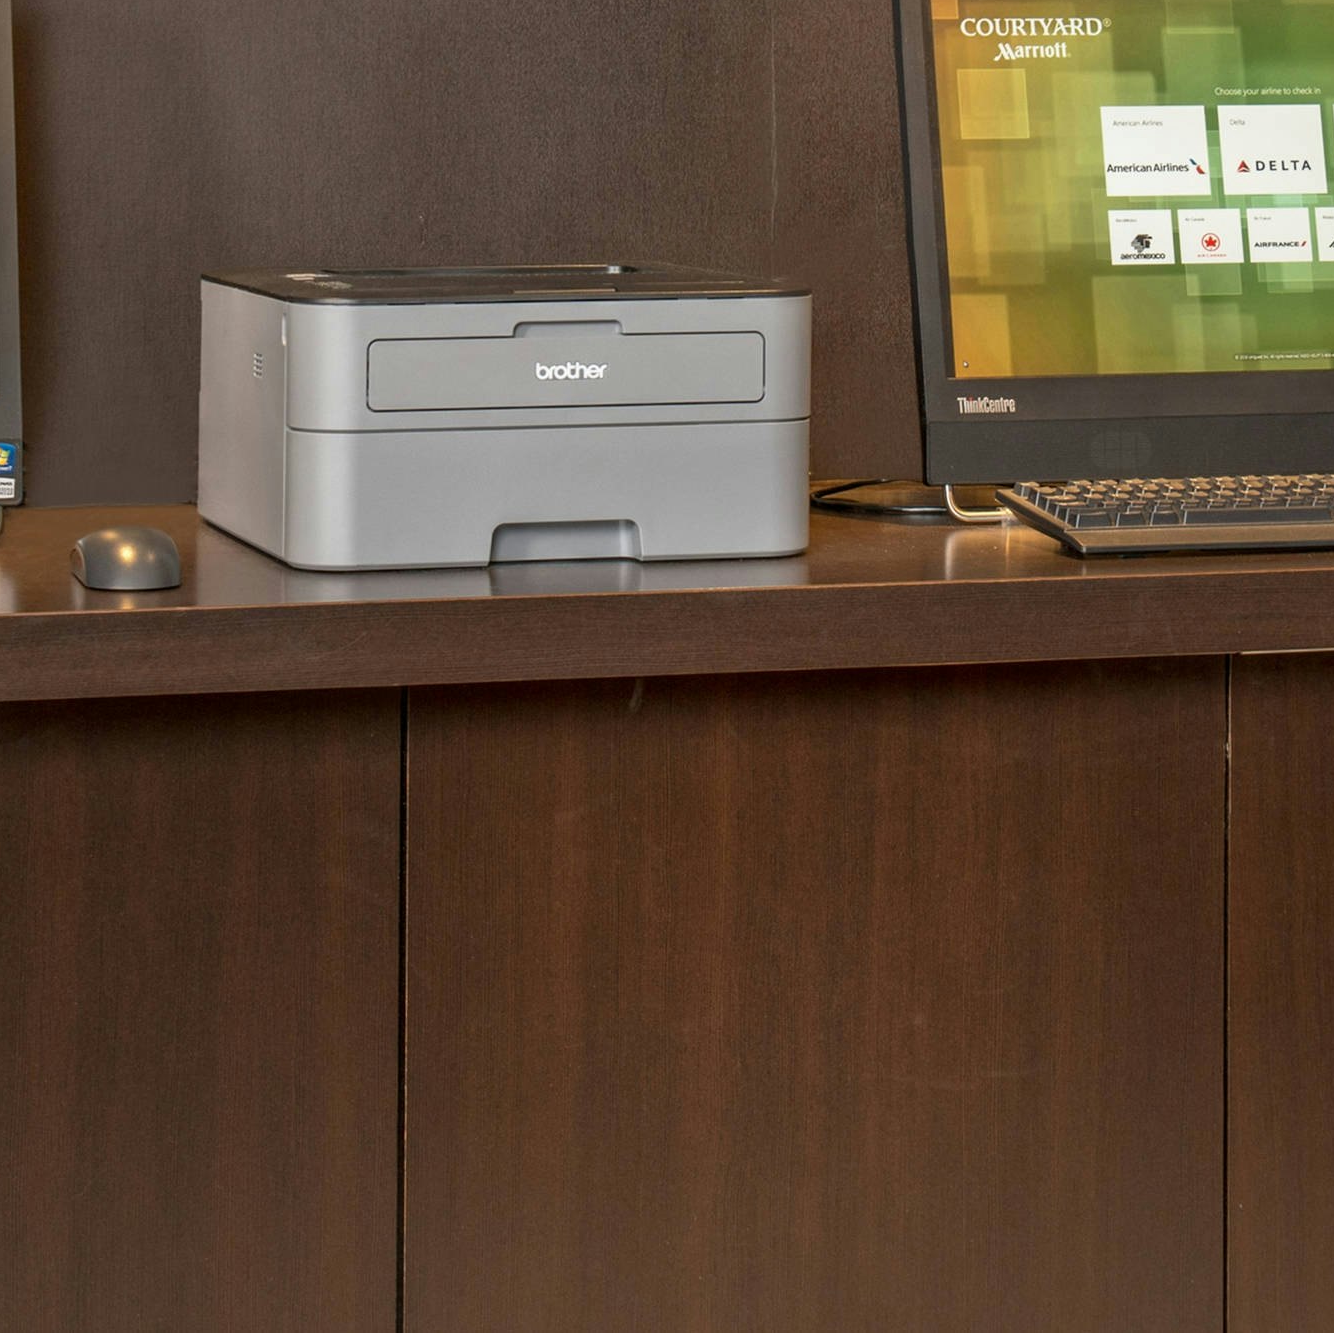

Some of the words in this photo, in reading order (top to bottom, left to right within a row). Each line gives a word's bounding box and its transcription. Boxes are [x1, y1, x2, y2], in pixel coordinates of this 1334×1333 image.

[960, 17, 1103, 37] COURTYARD
[993, 42, 1068, 62] Marriott
[1214, 86, 1242, 96] Choose
[1242, 88, 1260, 97] your
[1260, 87, 1282, 96] airline
[1283, 87, 1291, 95] to
[1292, 86, 1313, 95] check
[1314, 86, 1321, 95] in
[1107, 163, 1153, 173] American
[1153, 162, 1189, 172] Airlines
[1255, 160, 1312, 171] DELTA
[1120, 252, 1166, 260] aeromexico
[535, 361, 608, 380] brother
[957, 396, 1016, 414] ThinkCentre
